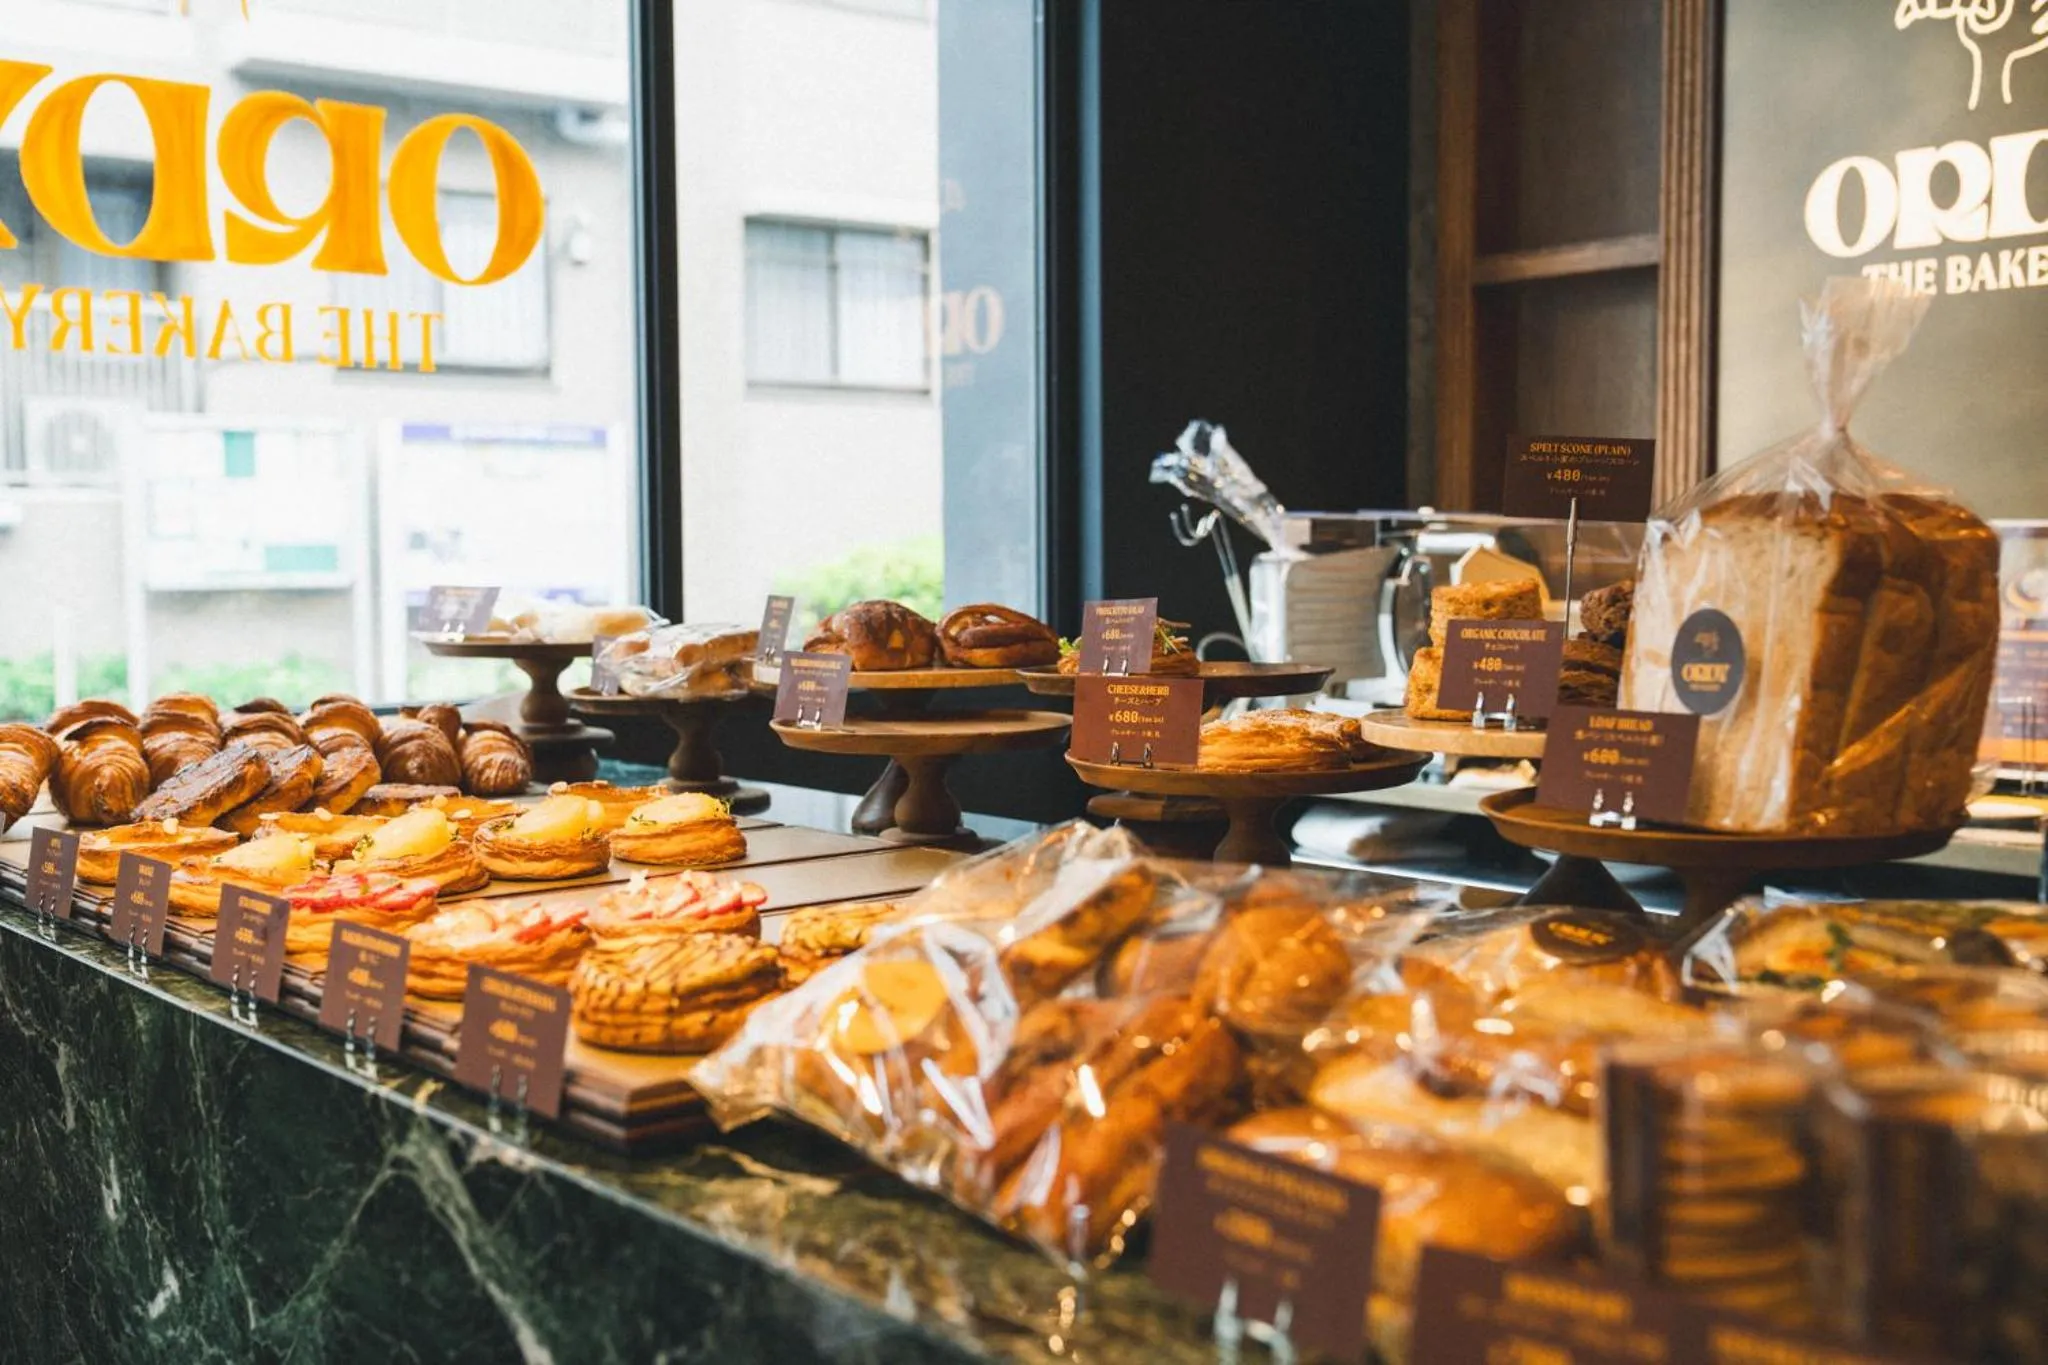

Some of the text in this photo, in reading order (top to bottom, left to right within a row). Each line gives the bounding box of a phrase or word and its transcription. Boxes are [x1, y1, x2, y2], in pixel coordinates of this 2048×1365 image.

[1861, 258, 1938, 296] THE
[1560, 443, 1593, 454] SCONE
[1594, 445, 1632, 456] (PLAIN)
[1107, 684, 1170, 696] CHEESE&HERB
[1108, 710, 1139, 724] ¥680
